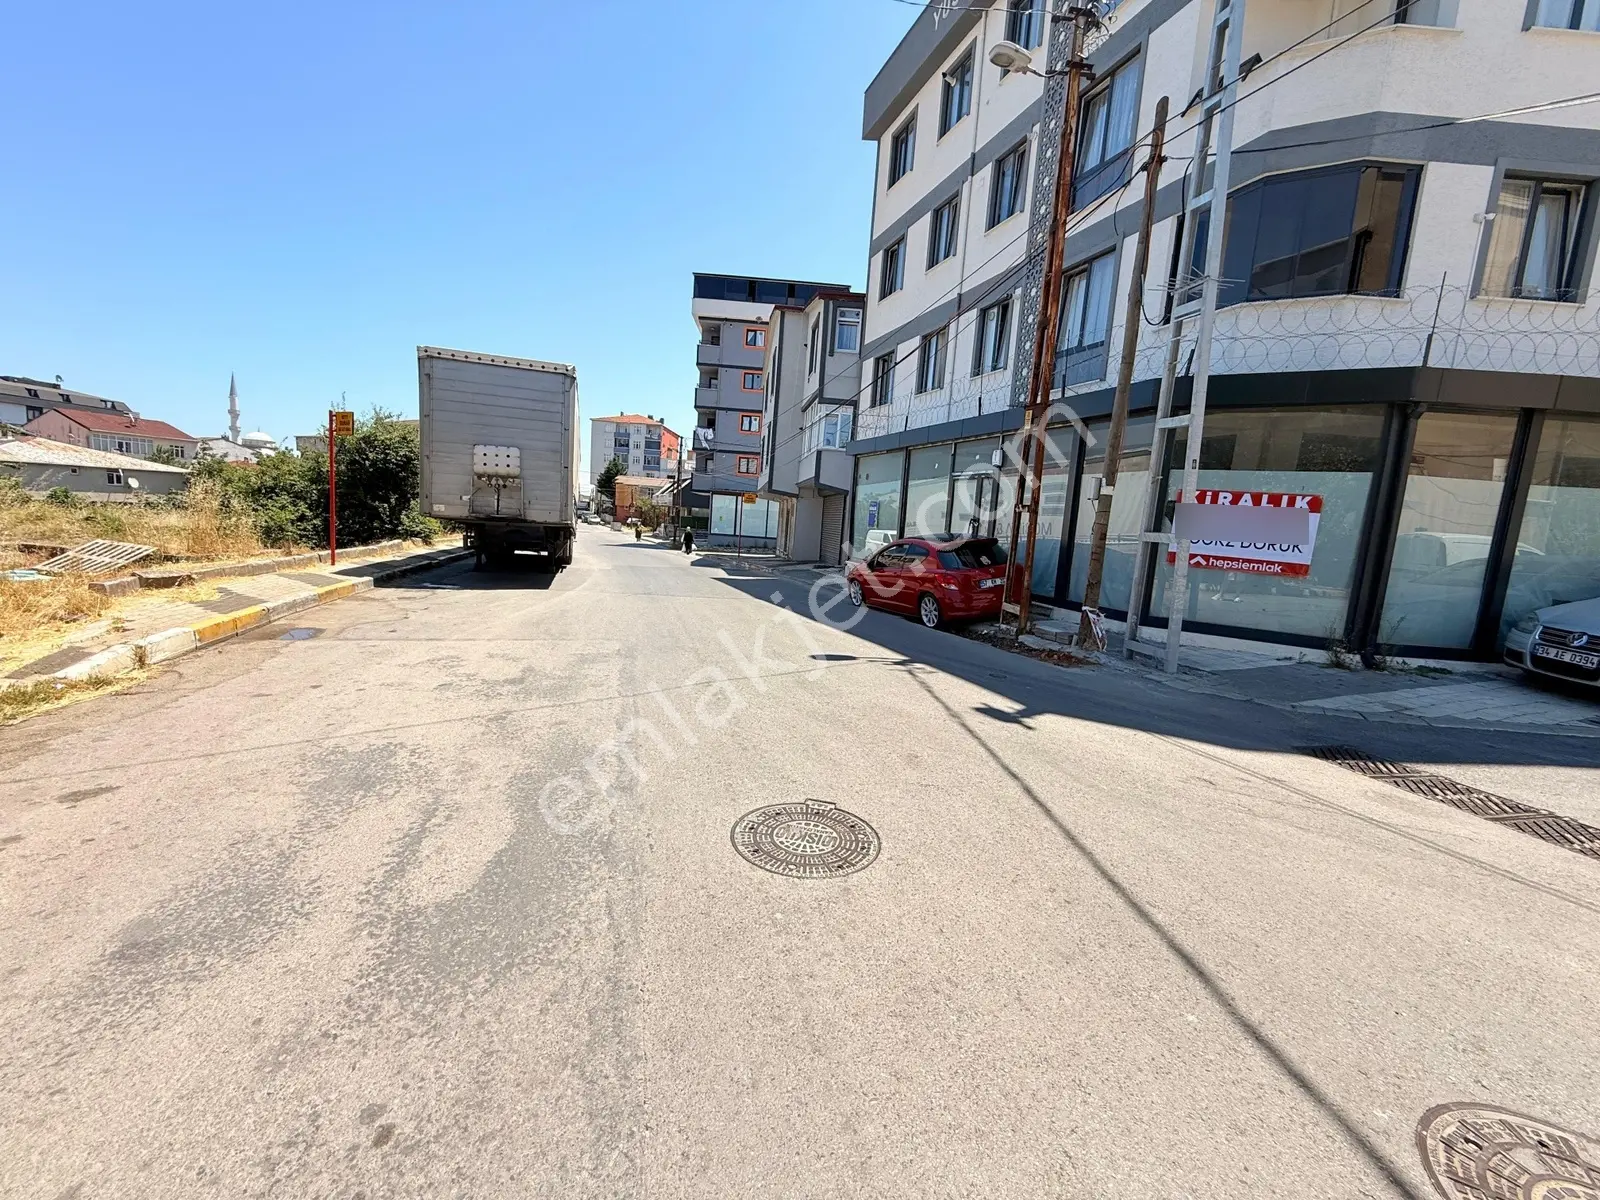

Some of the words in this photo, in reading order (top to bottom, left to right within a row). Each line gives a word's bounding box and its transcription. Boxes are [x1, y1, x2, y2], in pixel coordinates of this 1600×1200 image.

[1208, 557, 1283, 573] hepsiemlak
[1539, 645, 1550, 656] 34
[1553, 649, 1567, 660] AE
[1569, 653, 1596, 666] 0394
